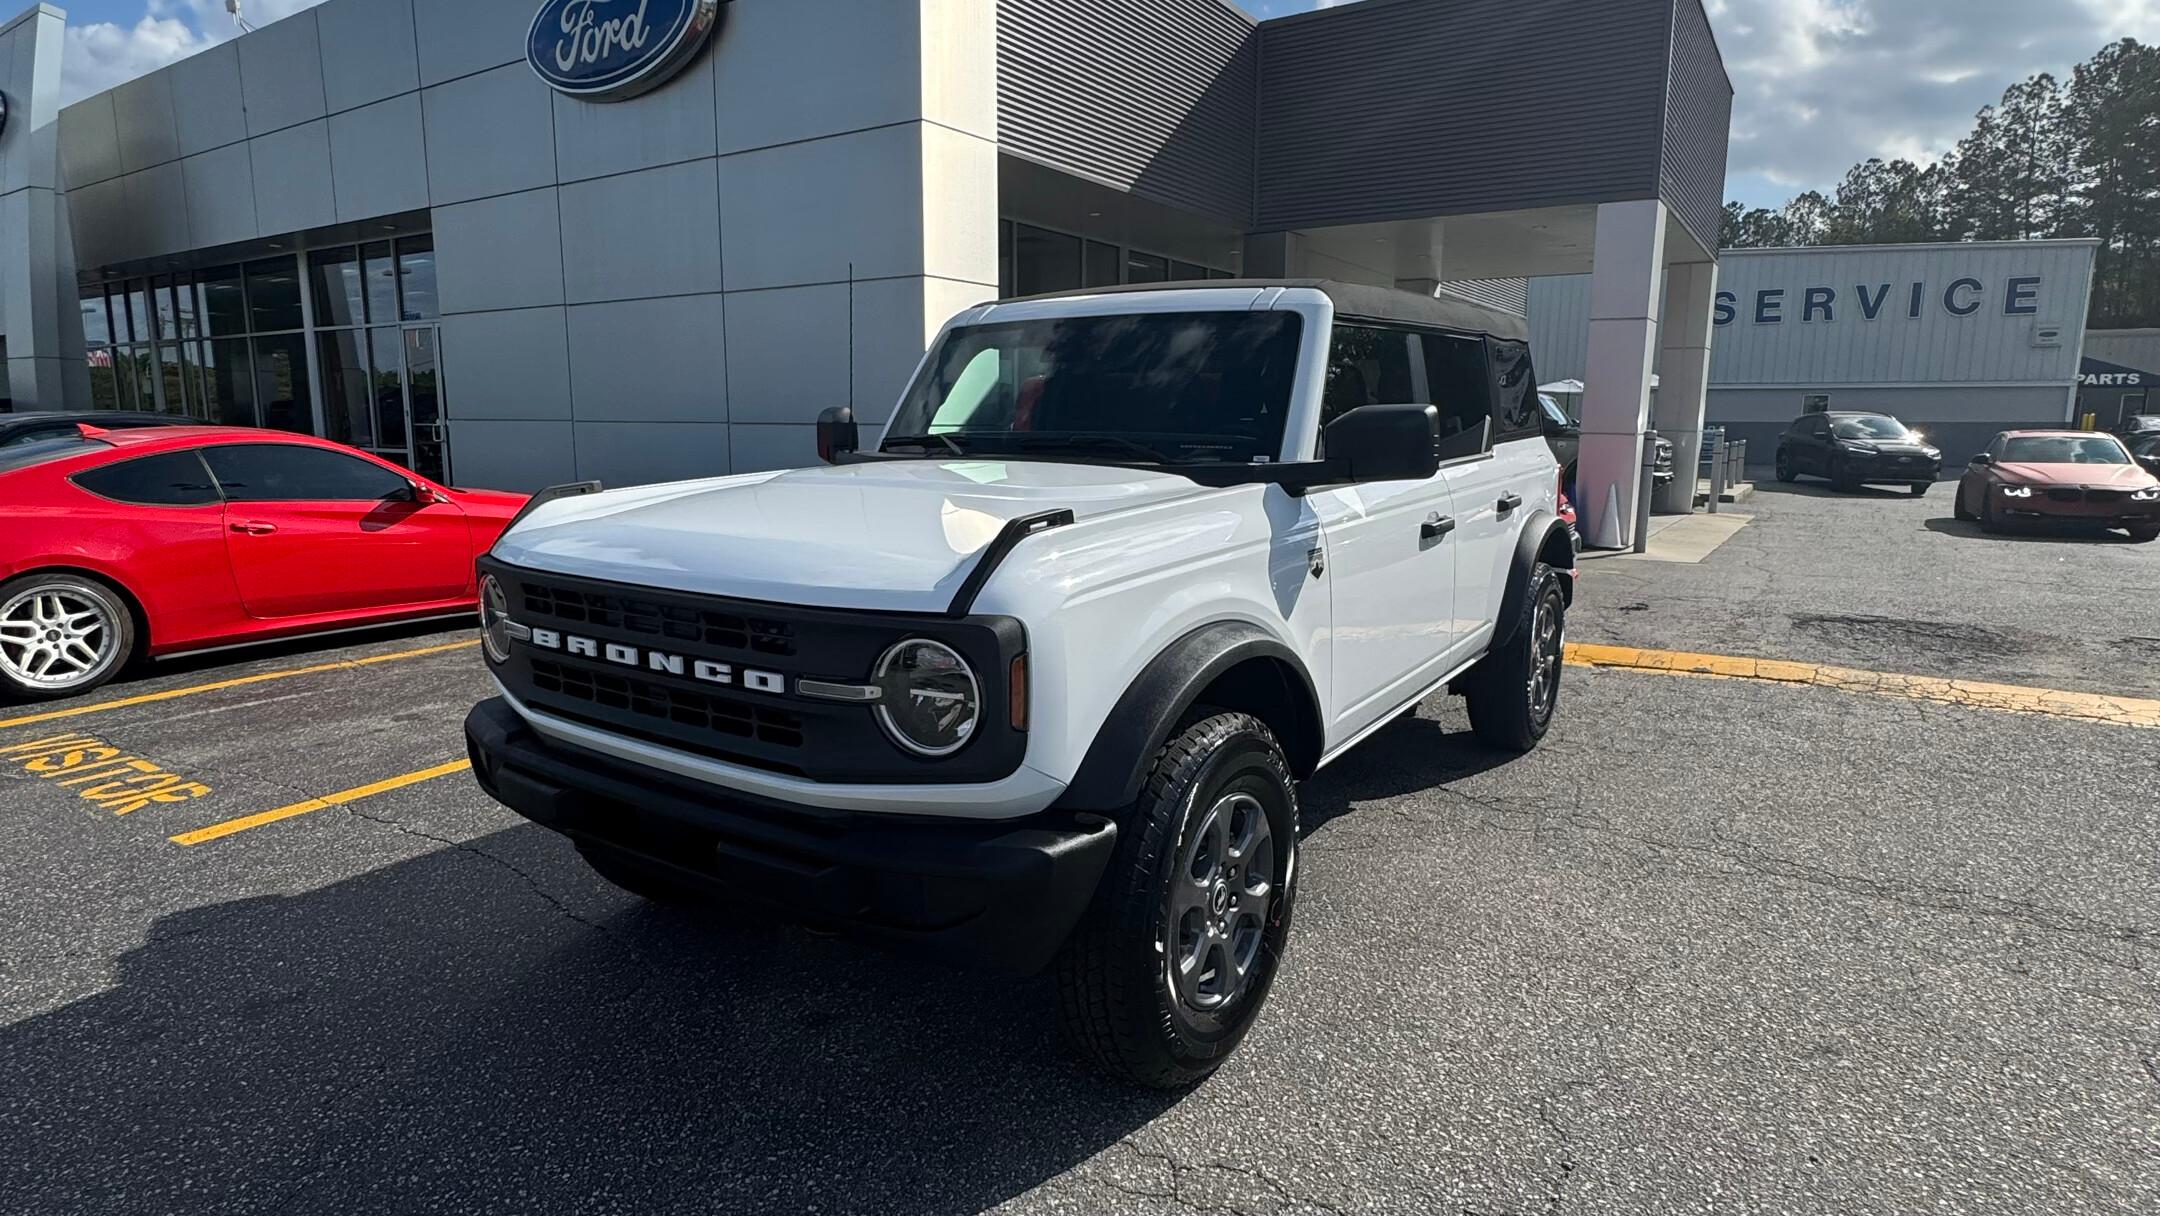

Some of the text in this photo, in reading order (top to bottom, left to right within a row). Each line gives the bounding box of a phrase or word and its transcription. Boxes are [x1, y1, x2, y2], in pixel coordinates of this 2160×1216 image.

[555, 0, 650, 72] Ford
[1713, 276, 2041, 325] SERVICE
[2075, 373, 2141, 385] PARTS
[533, 628, 785, 693] BRONCO
[0, 733, 213, 816] VISITOR
